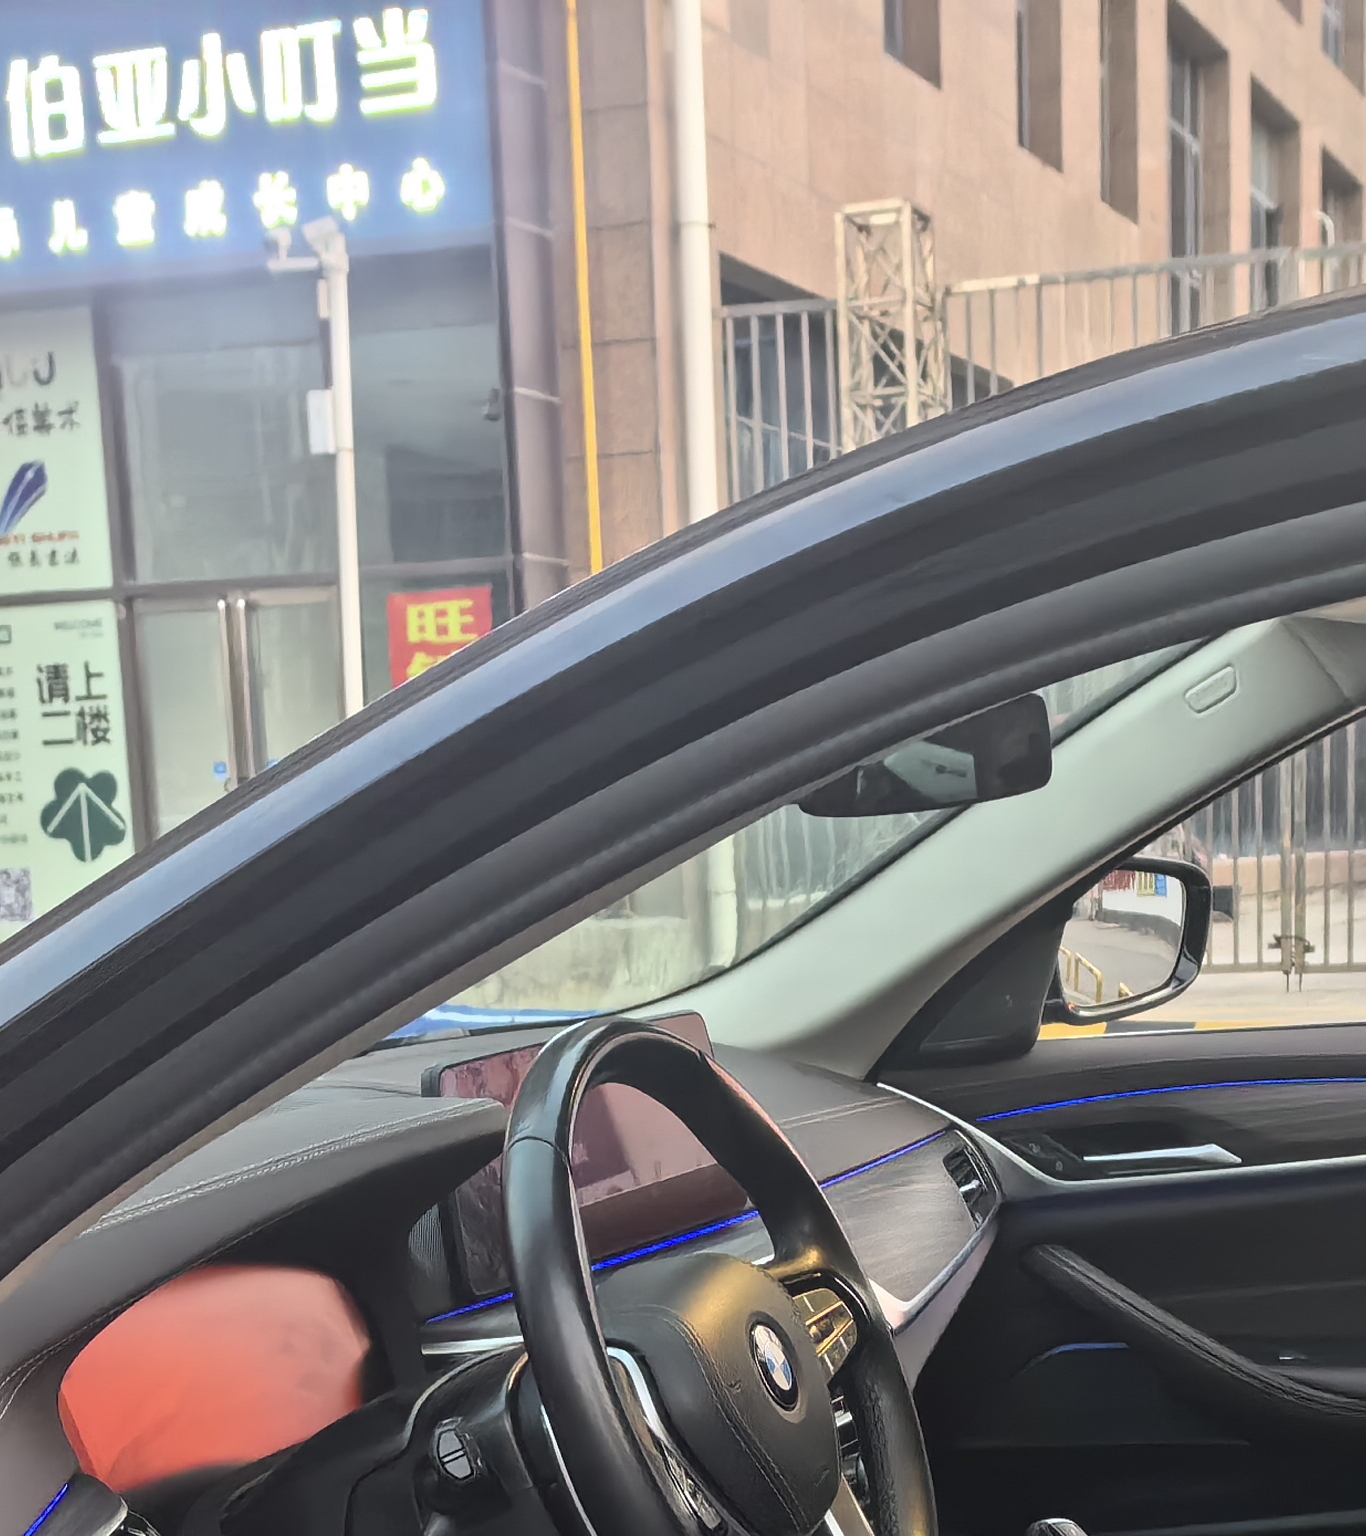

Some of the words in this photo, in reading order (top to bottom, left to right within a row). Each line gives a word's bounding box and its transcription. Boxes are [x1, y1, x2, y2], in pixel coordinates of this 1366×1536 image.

[5, 7, 440, 162] 伯亚小叮当
[36, 660, 108, 704] 请上
[41, 704, 111, 747] 二楼
